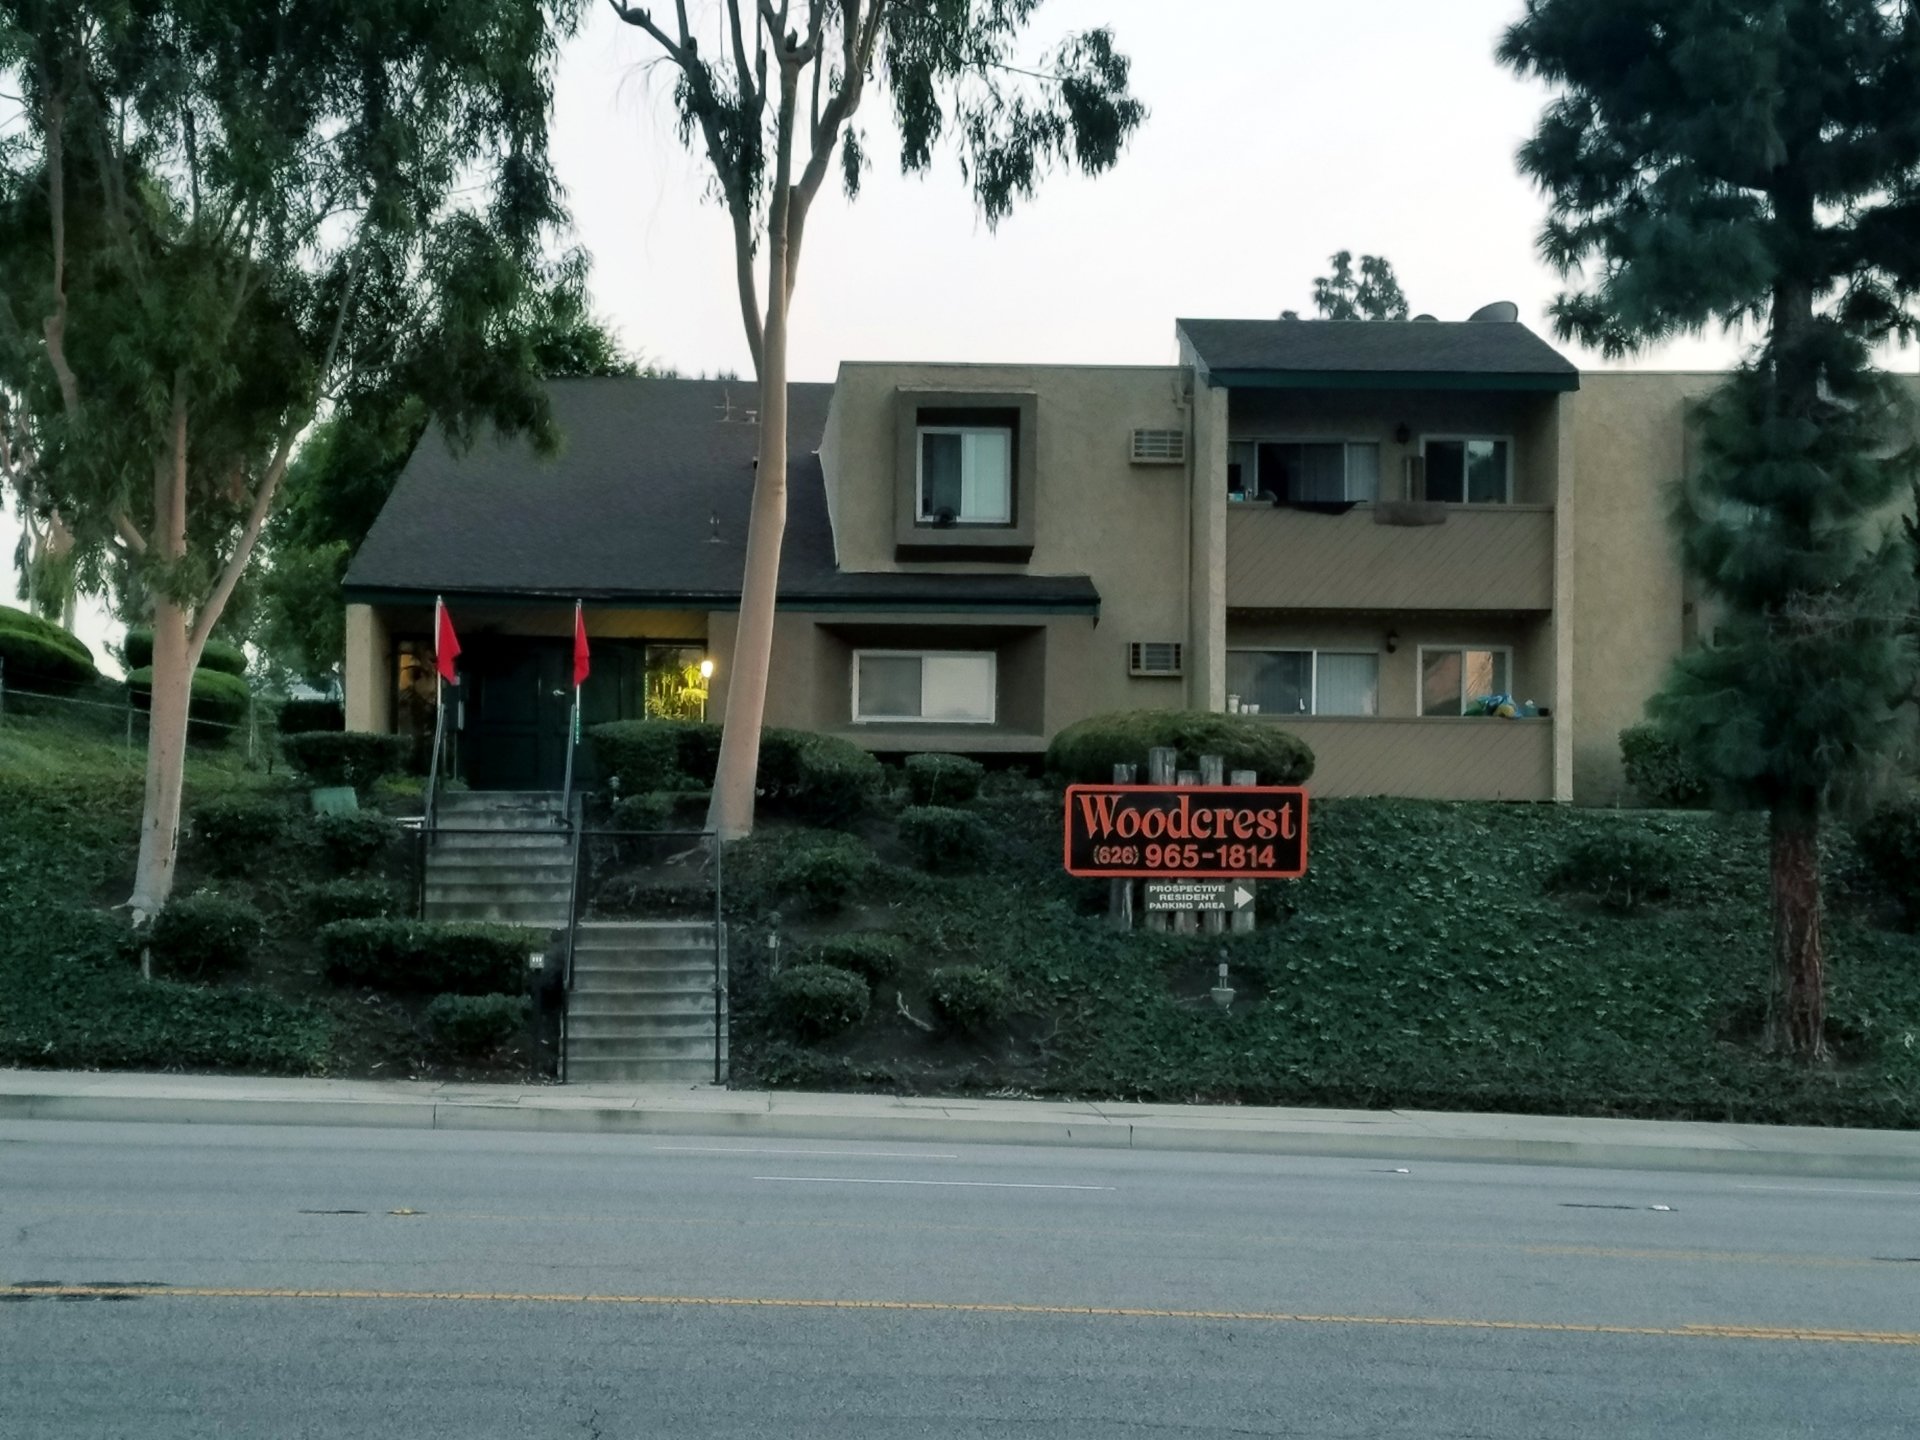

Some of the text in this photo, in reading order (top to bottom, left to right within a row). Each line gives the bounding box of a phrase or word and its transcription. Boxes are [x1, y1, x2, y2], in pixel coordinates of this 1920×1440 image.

[1077, 794, 1296, 840] Woodcrest
[1093, 843, 1276, 869] (626) 965-1814
[1149, 884, 1226, 893] PROSPECTIVE
[1159, 893, 1216, 901] RESIDENT
[1149, 902, 1226, 910] PARKING AREA
